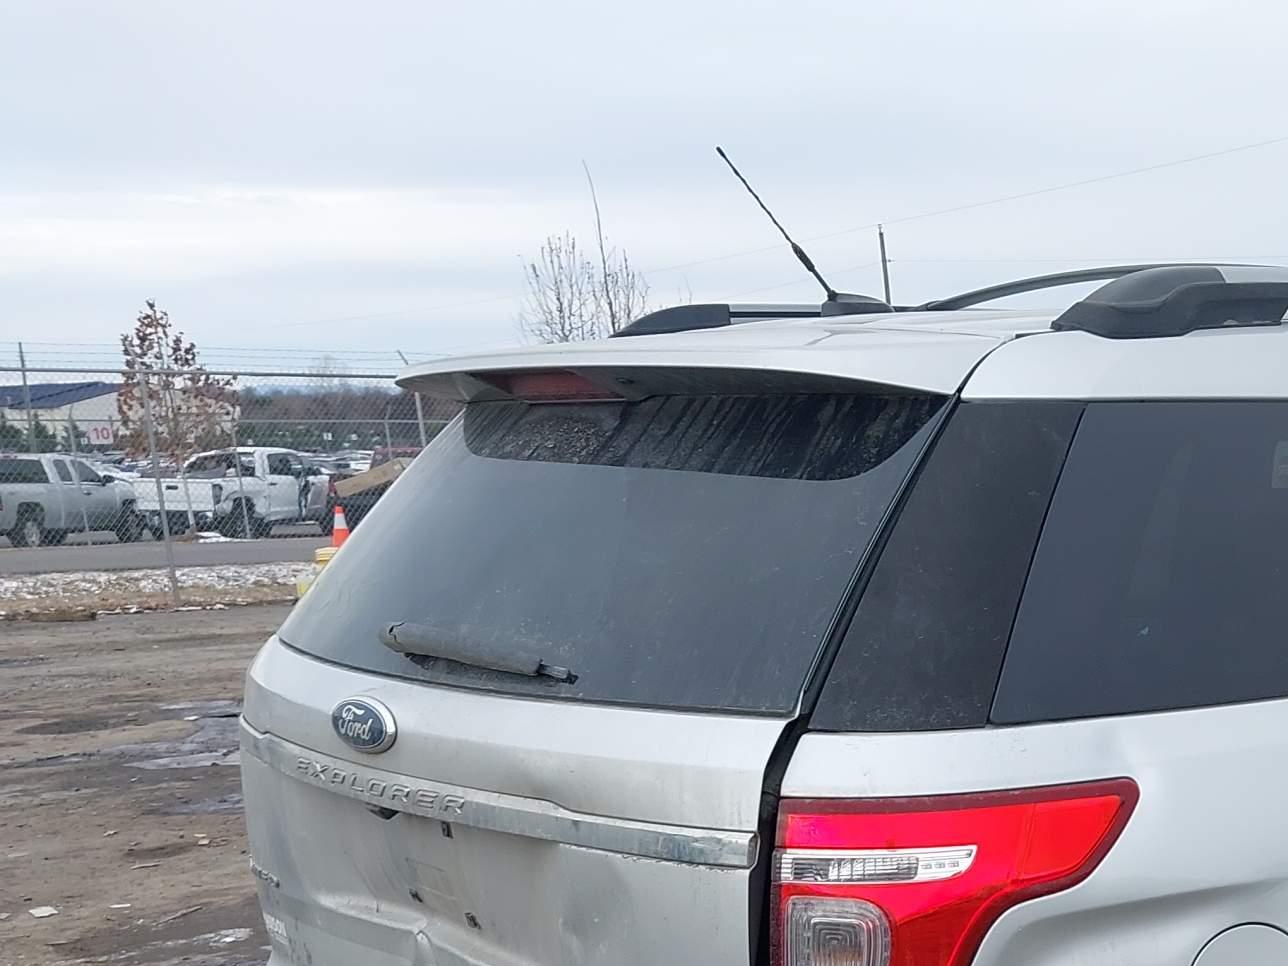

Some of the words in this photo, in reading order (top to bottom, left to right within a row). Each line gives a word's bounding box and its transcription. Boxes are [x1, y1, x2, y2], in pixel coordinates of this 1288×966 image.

[92, 427, 110, 440] 10
[337, 705, 374, 740] Ford
[297, 757, 466, 816] EXPLORER
